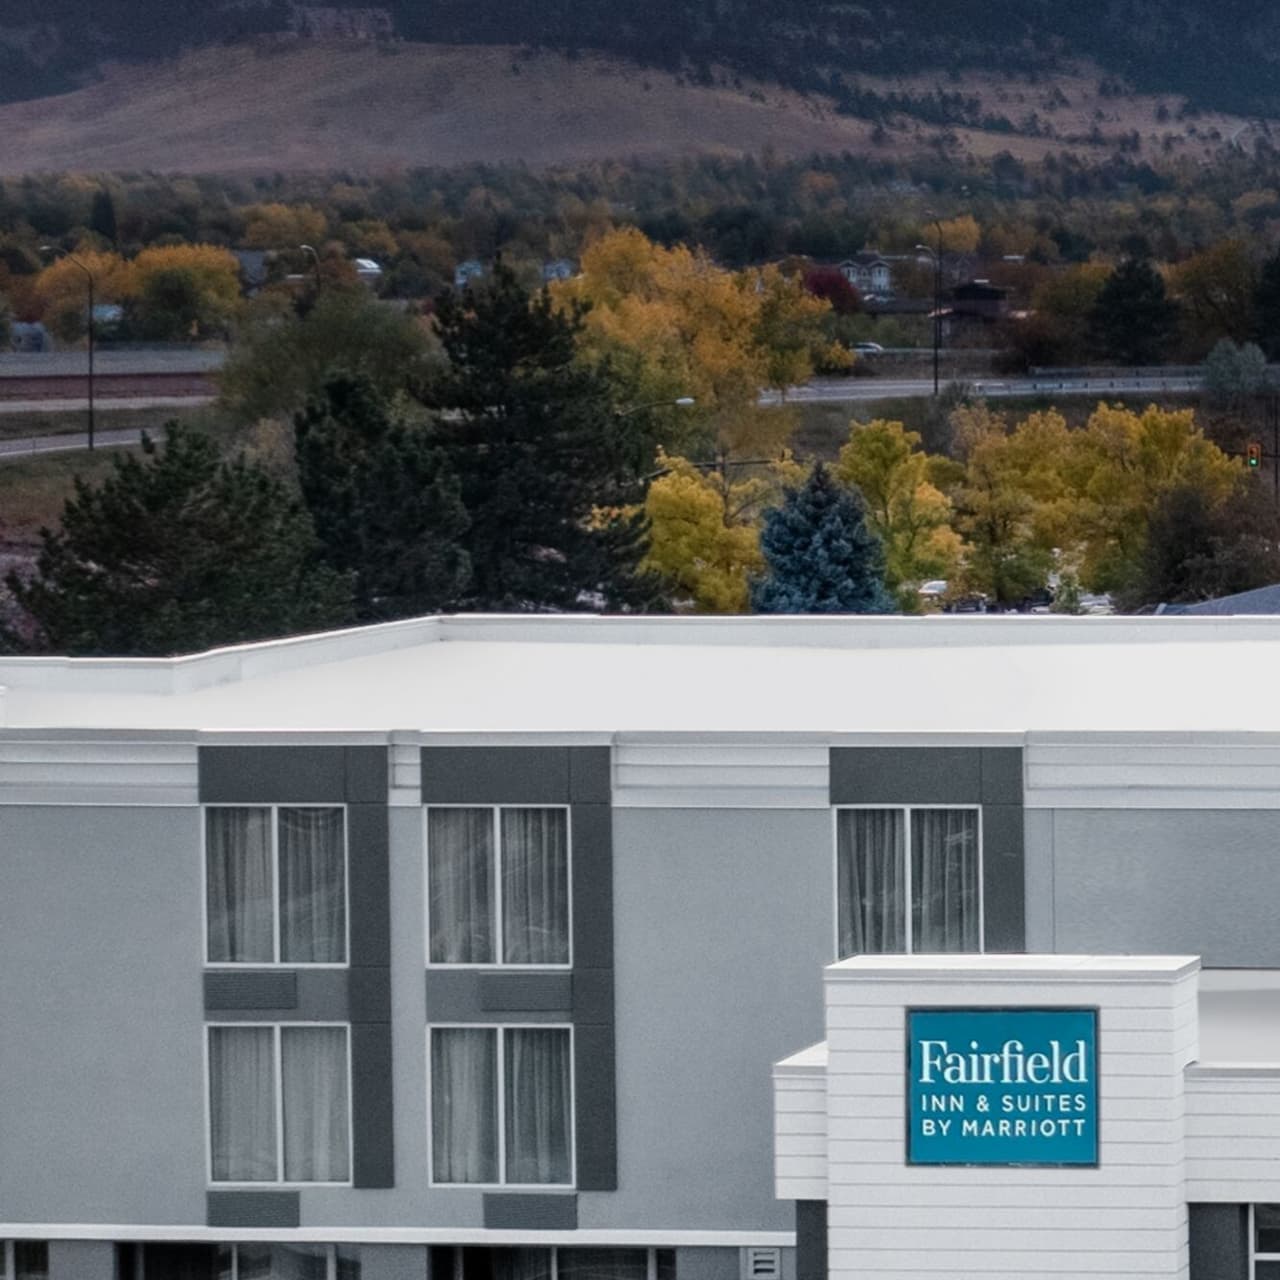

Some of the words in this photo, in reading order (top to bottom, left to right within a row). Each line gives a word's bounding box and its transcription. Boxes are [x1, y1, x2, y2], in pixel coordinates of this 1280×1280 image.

[918, 1039, 1089, 1084] Fairfield
[921, 1094, 965, 1112] INN
[976, 1094, 990, 1112] &
[1001, 1093, 1087, 1112] SUITES
[921, 1119, 952, 1136] BY
[961, 1118, 1086, 1137] MARRIOTT
